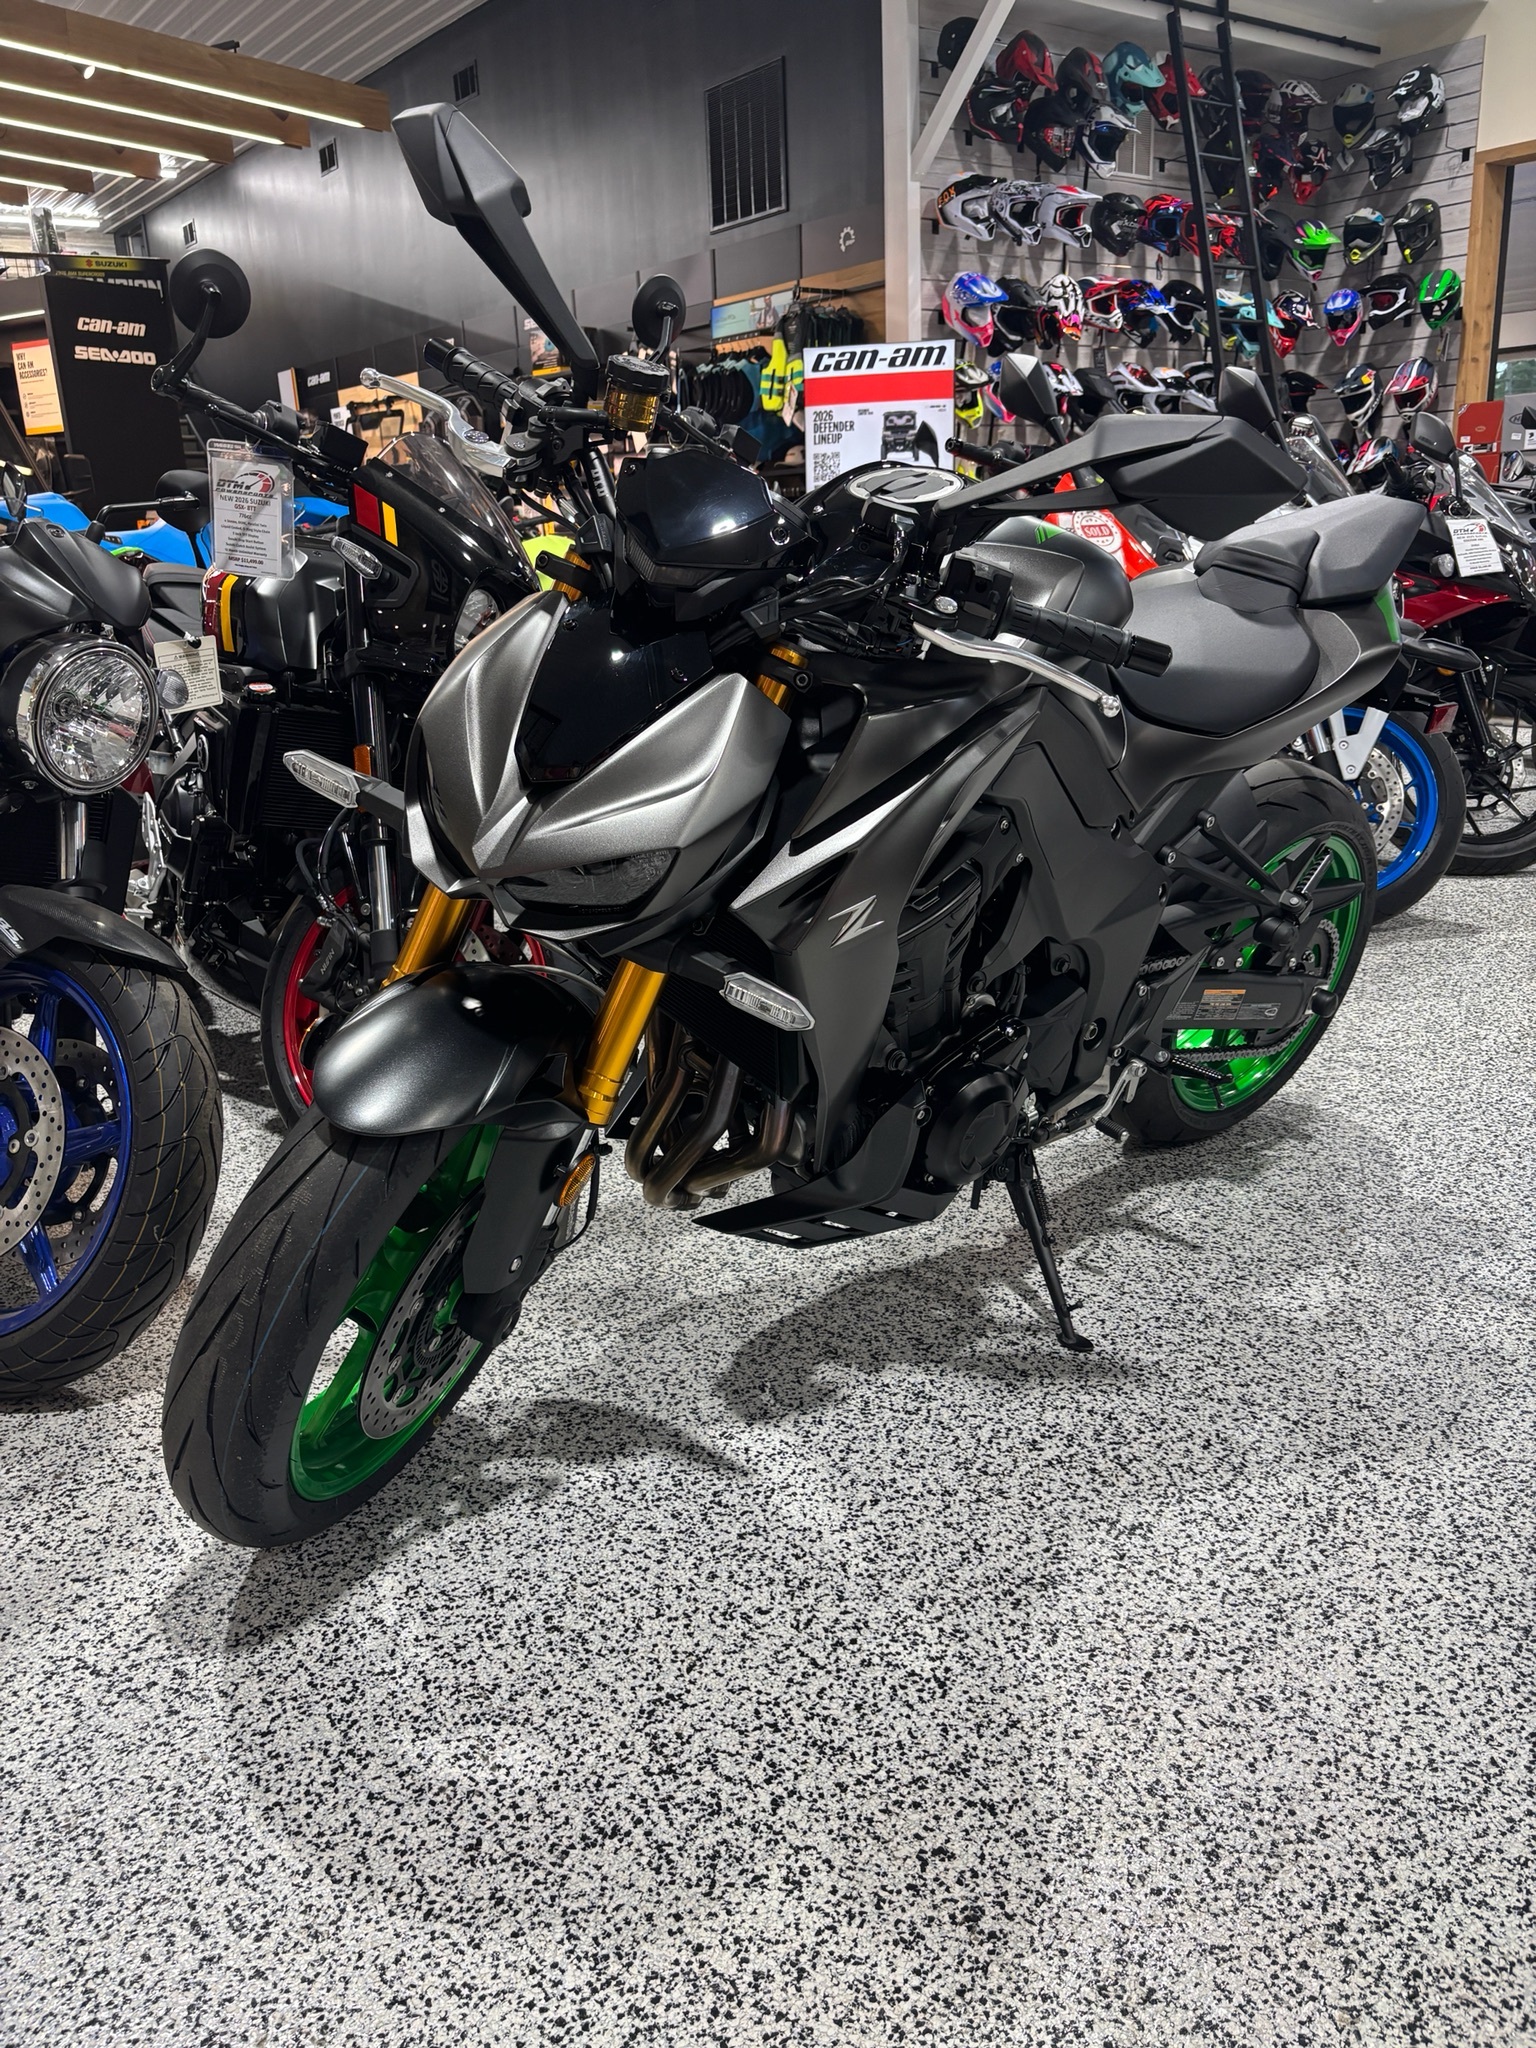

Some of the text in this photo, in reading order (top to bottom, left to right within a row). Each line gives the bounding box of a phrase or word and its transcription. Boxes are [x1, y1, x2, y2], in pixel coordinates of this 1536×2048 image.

[937, 185, 956, 208] FOX
[94, 260, 127, 268] SUZUKI
[77, 316, 146, 337] can-am
[811, 345, 946, 373] can-am
[18, 362, 26, 370] CAN
[19, 368, 47, 380] ACCESSORIES?
[813, 410, 834, 422] 2026
[813, 421, 855, 434] DEFENDER
[813, 433, 843, 446] LINEUP
[216, 478, 245, 490] DTM
[220, 494, 271, 506] NEW 2026 SUZUKI
[1083, 525, 1111, 537] SOLD
